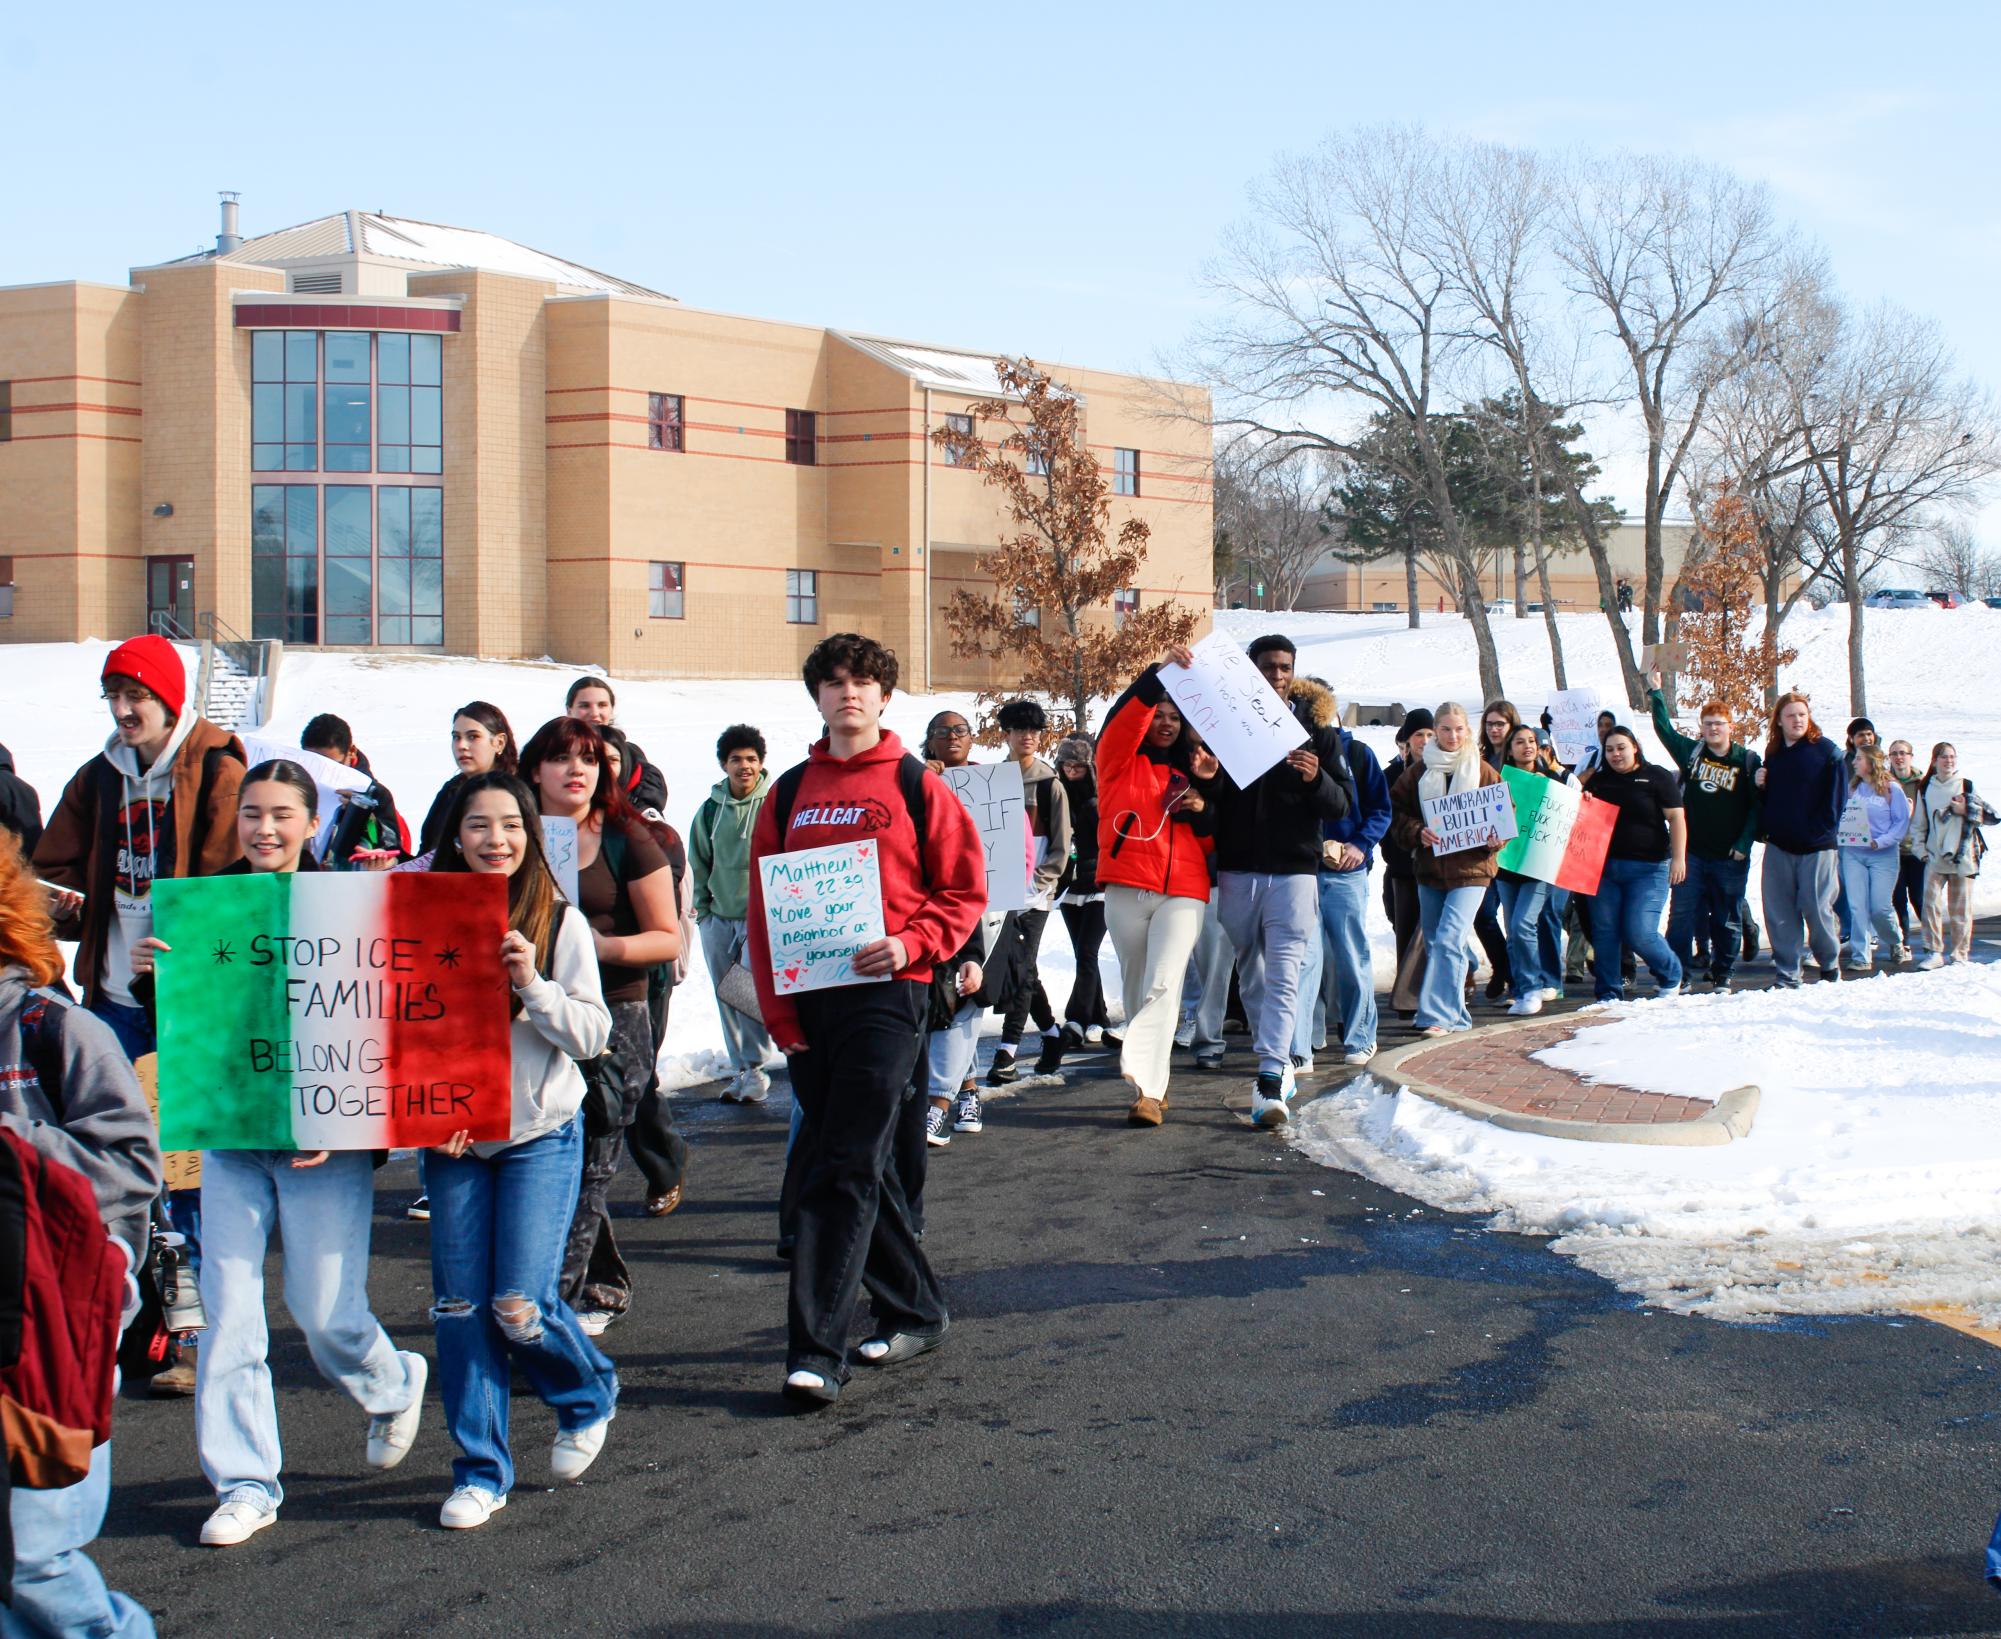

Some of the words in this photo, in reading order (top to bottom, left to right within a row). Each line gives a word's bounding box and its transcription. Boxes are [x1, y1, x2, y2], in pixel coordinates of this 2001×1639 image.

[1432, 785, 1504, 814] IMMIGRANTS
[793, 807, 866, 829] HELLCAT
[979, 797, 1022, 832] IF
[1443, 806, 1488, 831] BUILT
[1440, 824, 1499, 853] AMERICA
[1520, 825, 1551, 843] FUCK
[769, 857, 853, 887] Matthew
[815, 873, 865, 896] 22:39
[825, 900, 856, 922] your
[782, 924, 846, 947] neighbor
[250, 934, 341, 967] STOP
[356, 936, 423, 972] ICE
[285, 979, 446, 1022] FAMILIES
[250, 1038, 391, 1074] BELONG
[291, 1081, 476, 1119] TOGETHER
